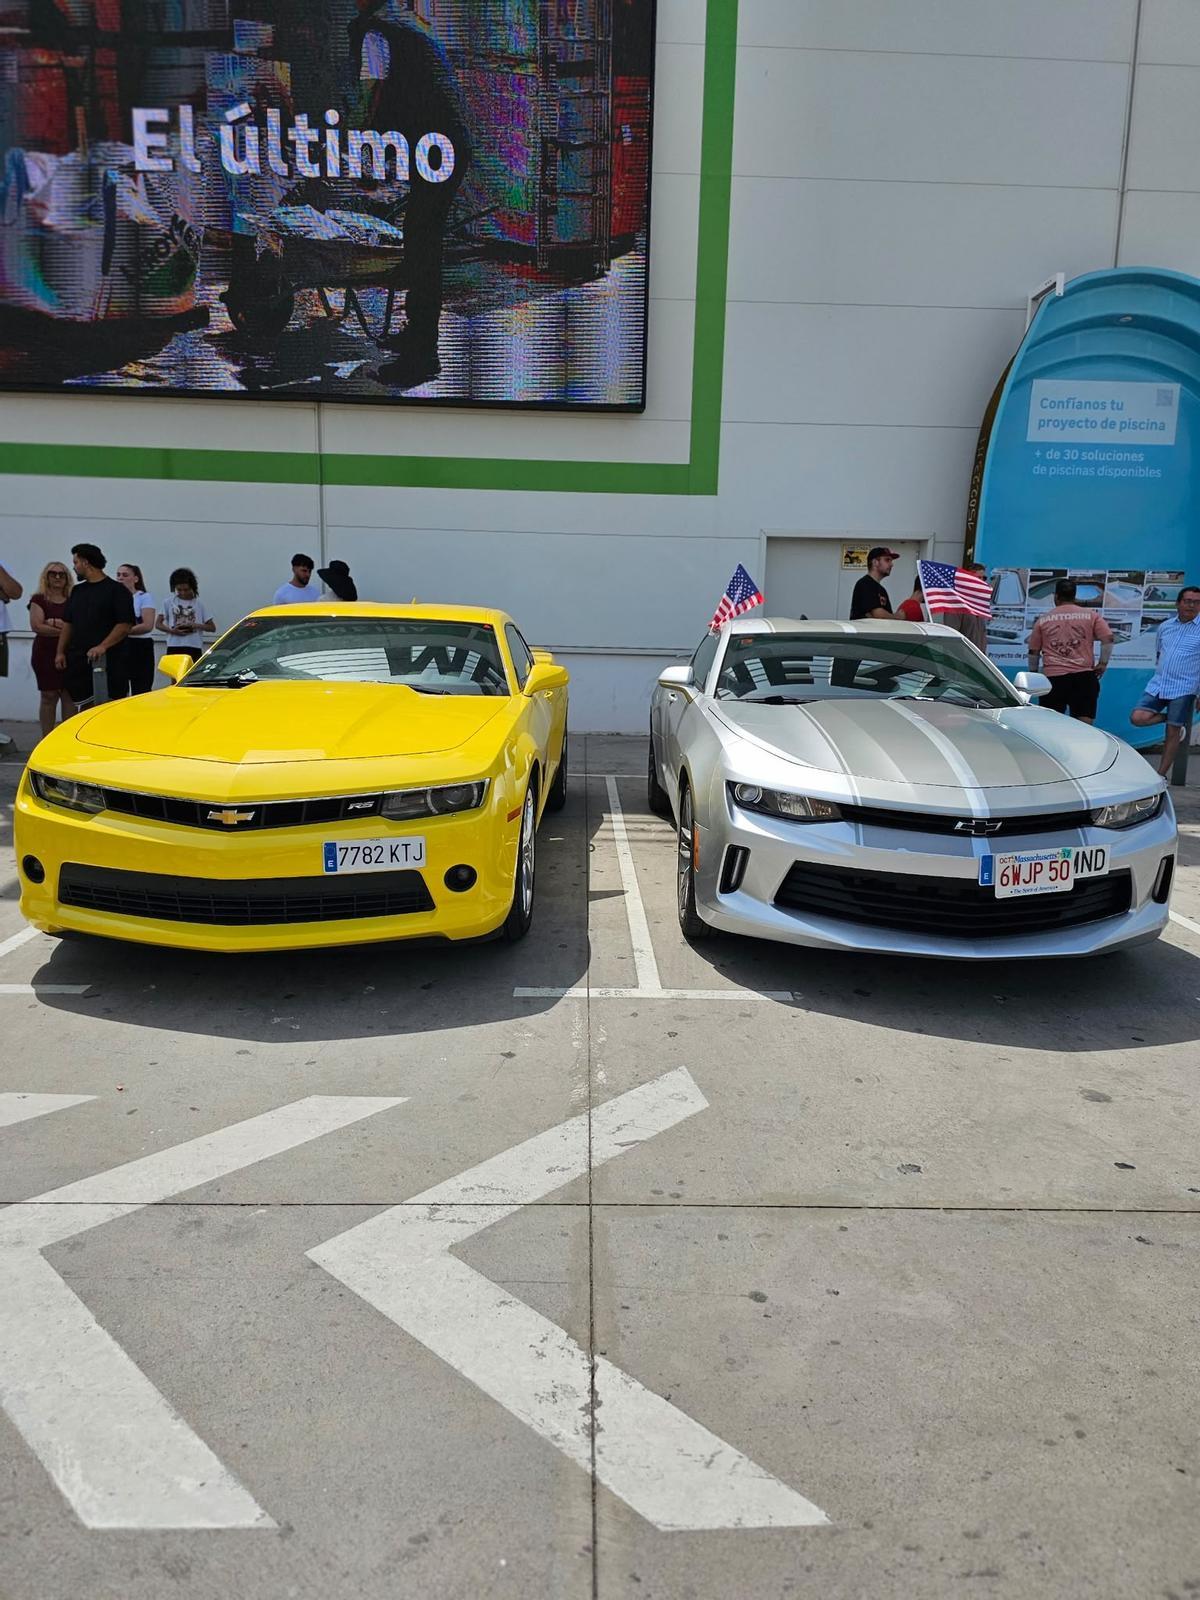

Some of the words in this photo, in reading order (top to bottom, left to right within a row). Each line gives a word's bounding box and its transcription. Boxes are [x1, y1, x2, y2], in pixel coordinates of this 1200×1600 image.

[132, 104, 201, 174] El
[220, 102, 456, 184] último
[1039, 396, 1106, 411] Confíanos
[1111, 399, 1124, 411] tu
[1038, 417, 1098, 431] proyecto
[1101, 417, 1117, 430] de
[1119, 417, 1166, 432] piscina
[1046, 449, 1061, 460] de
[1063, 449, 1079, 461] 30
[1082, 449, 1145, 462] soluciones
[1032, 463, 1047, 475] de
[1049, 464, 1095, 478] piscinas
[1097, 465, 1162, 479] disponibles
[347, 801, 375, 810] RS
[327, 860, 335, 868] E
[339, 845, 384, 867] 7782
[390, 842, 423, 864] KTJ
[1014, 852, 1058, 864] Massachusetts
[983, 872, 990, 880] E
[1000, 862, 1043, 887] 6WJP
[1048, 859, 1071, 882] 50
